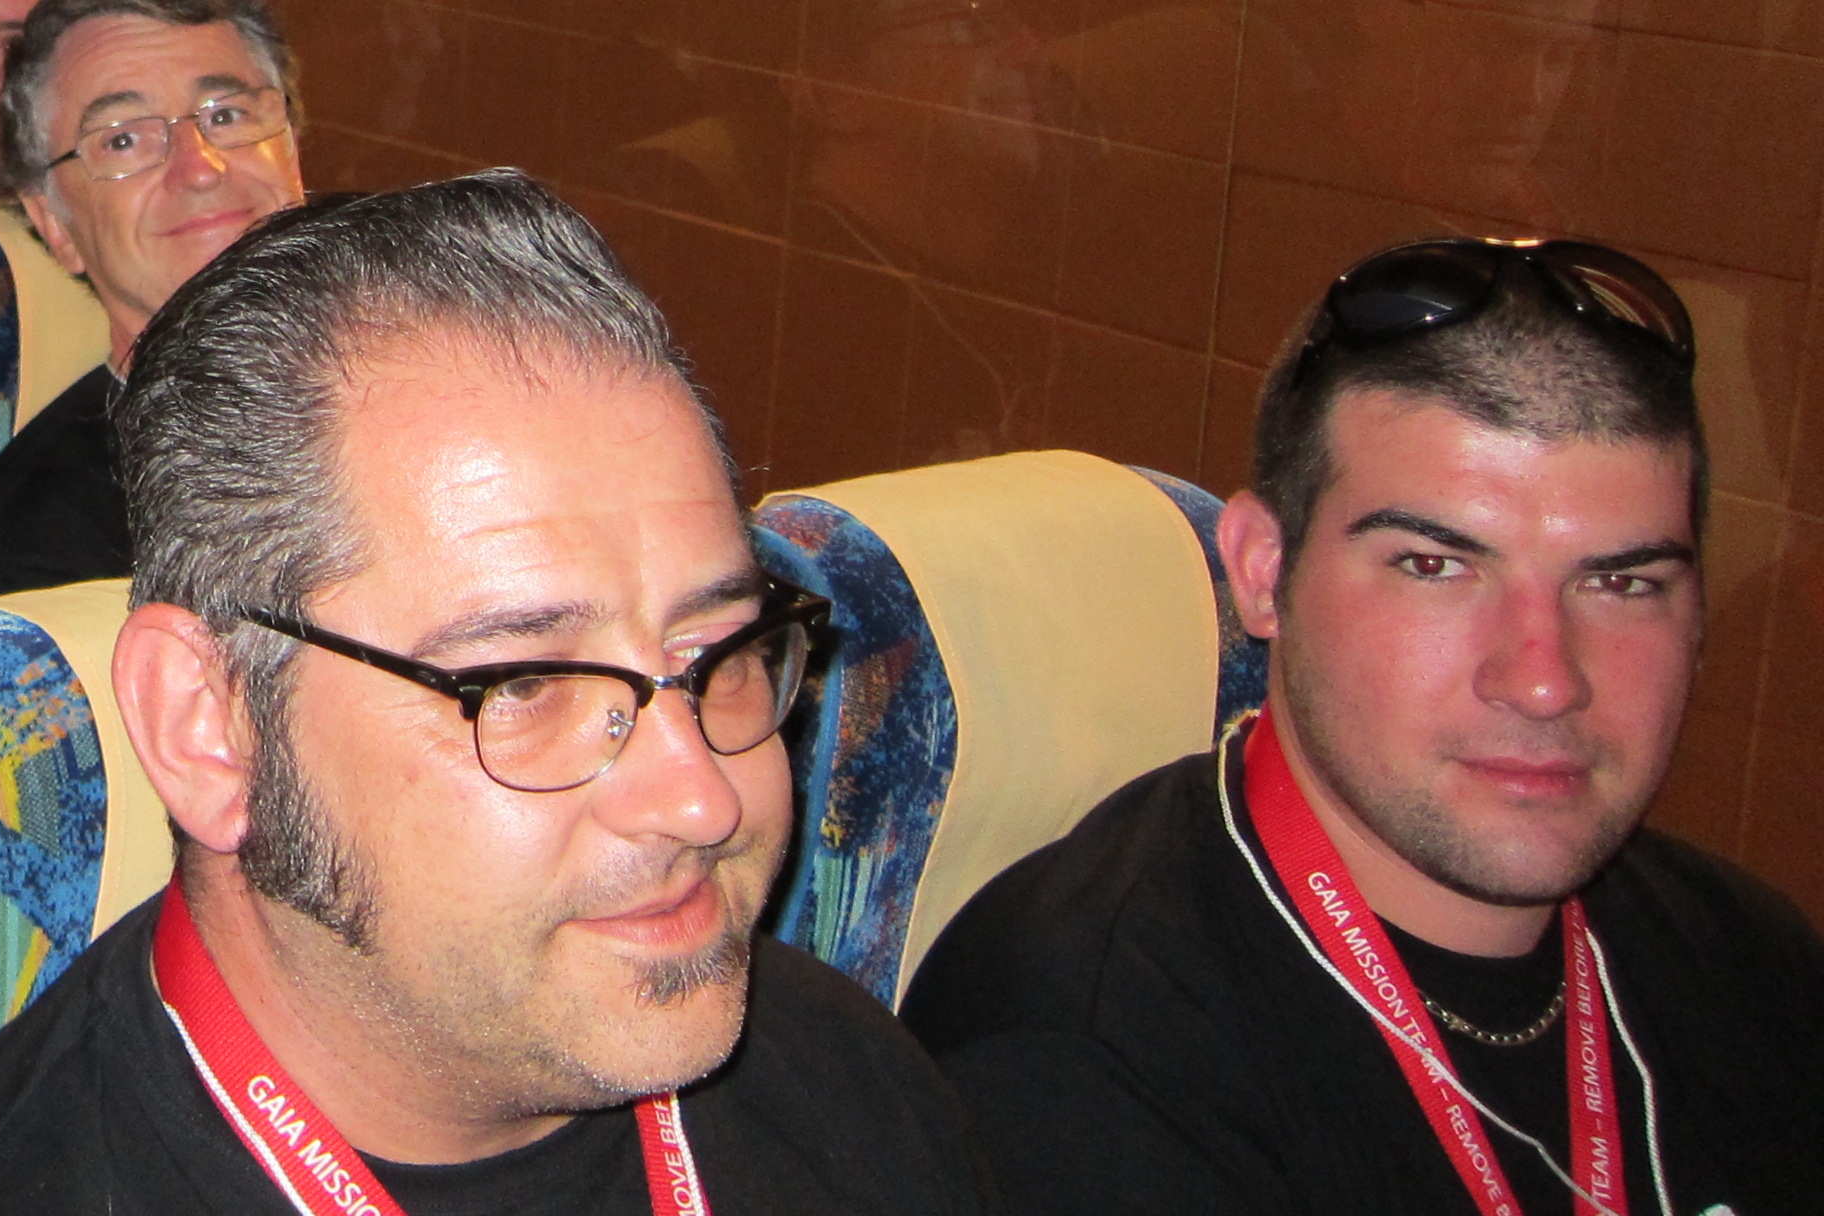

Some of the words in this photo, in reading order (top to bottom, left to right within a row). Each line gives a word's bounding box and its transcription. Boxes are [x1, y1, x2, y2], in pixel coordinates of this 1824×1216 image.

[1308, 872, 1352, 928] GAIA
[1341, 926, 1409, 1019] MISSION
[1446, 1103, 1504, 1203] REMOVE
[1579, 1020, 1604, 1114] REMOVE
[247, 1074, 307, 1147] GAIA
[1590, 1136, 1613, 1201] TEAM
